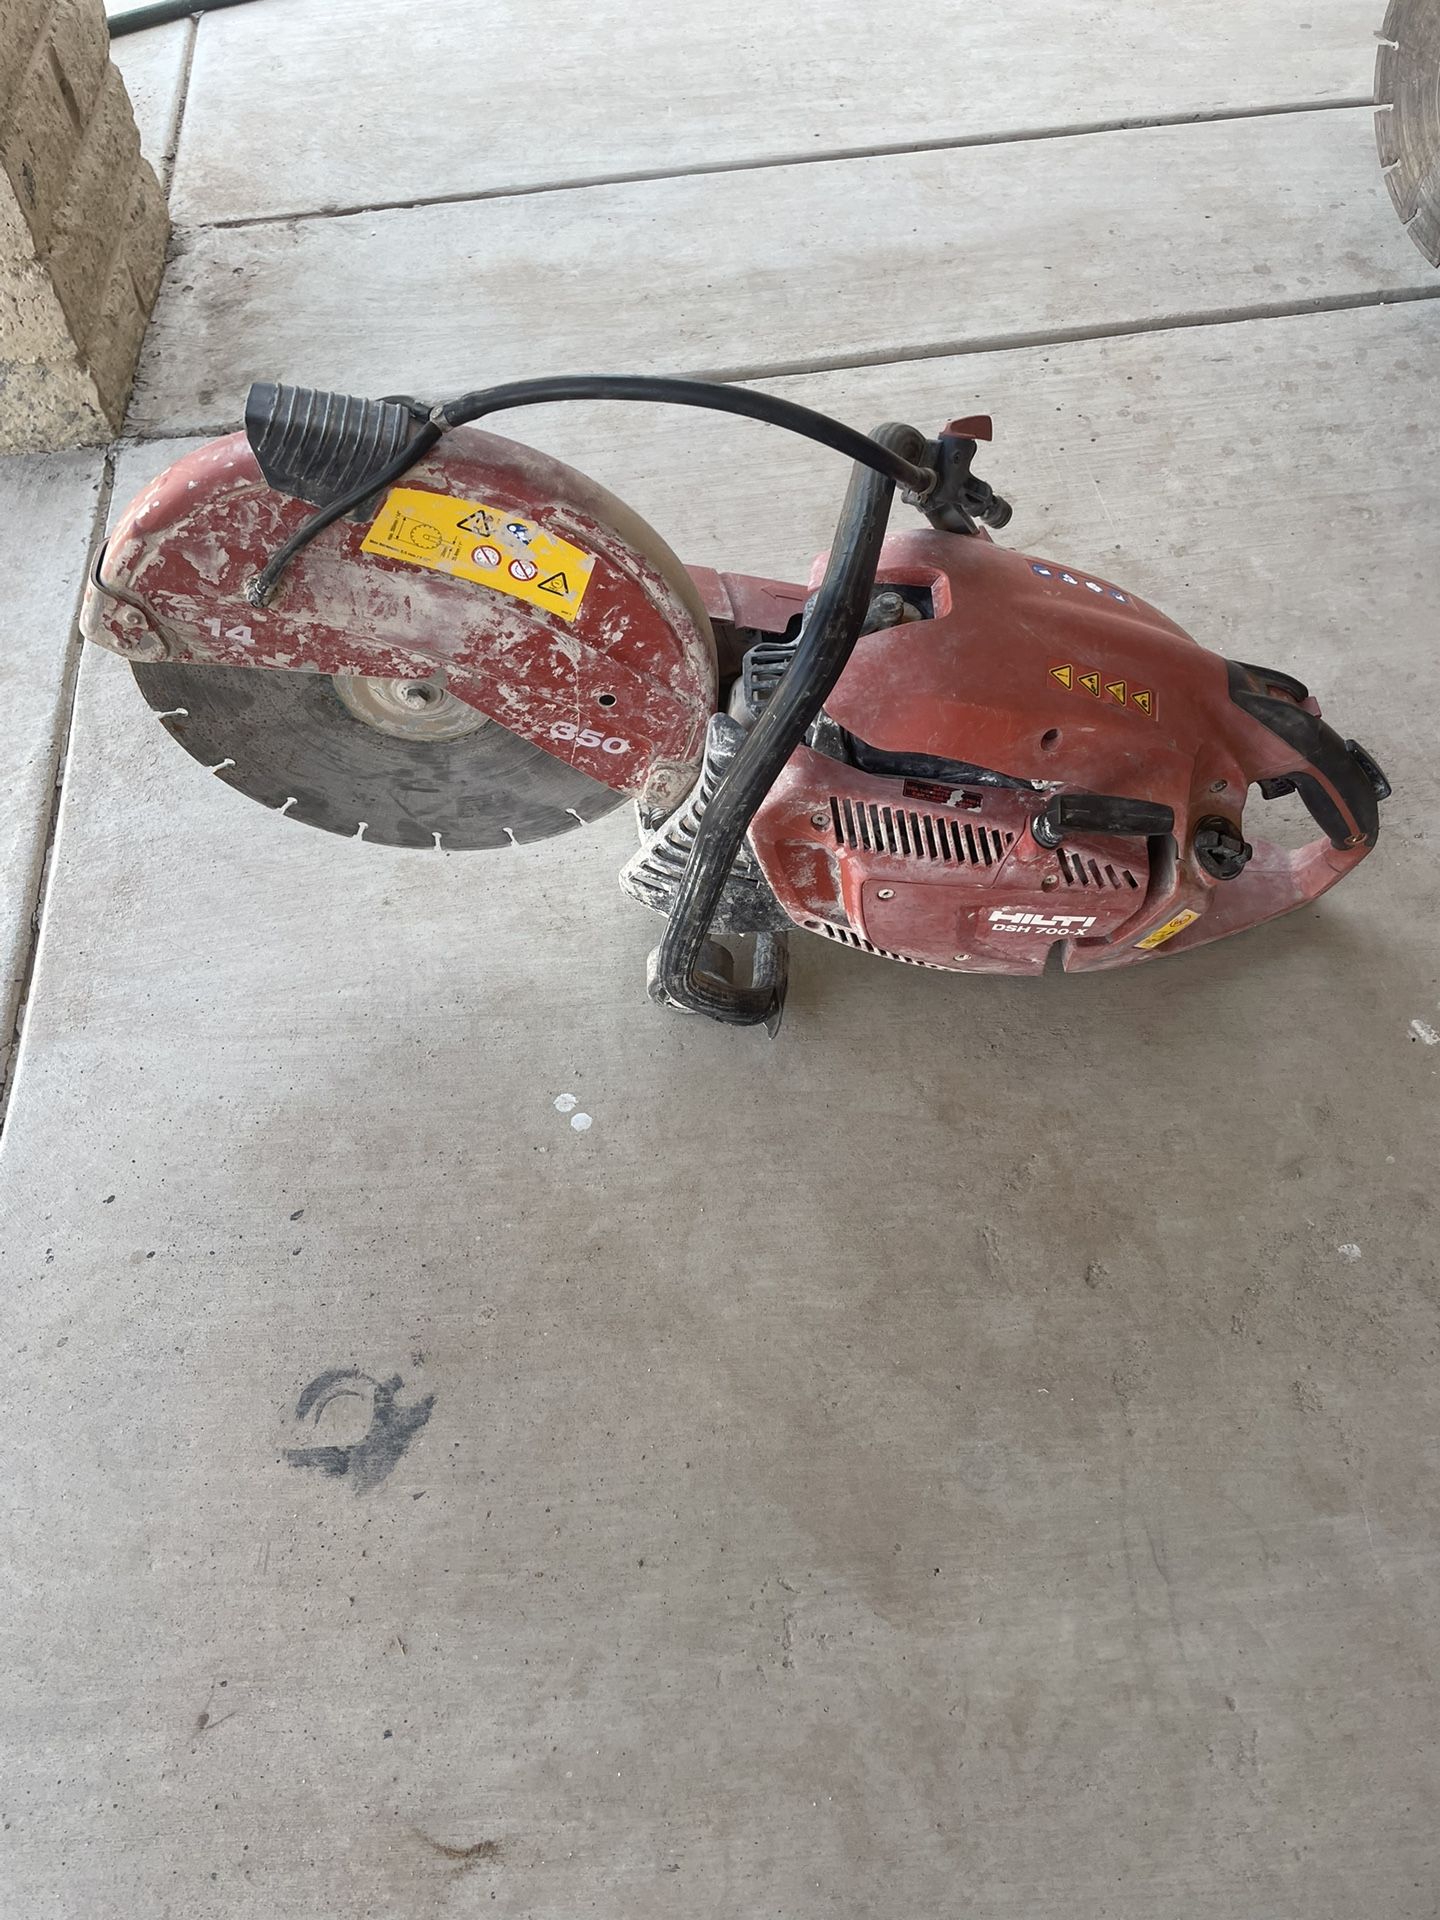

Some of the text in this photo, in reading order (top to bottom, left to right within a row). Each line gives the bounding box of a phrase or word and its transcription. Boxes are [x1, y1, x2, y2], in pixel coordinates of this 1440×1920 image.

[203, 617, 256, 646] 14
[549, 720, 629, 754] 350
[988, 910, 1097, 927] HILTI
[991, 923, 1088, 936] DSH 700-X
